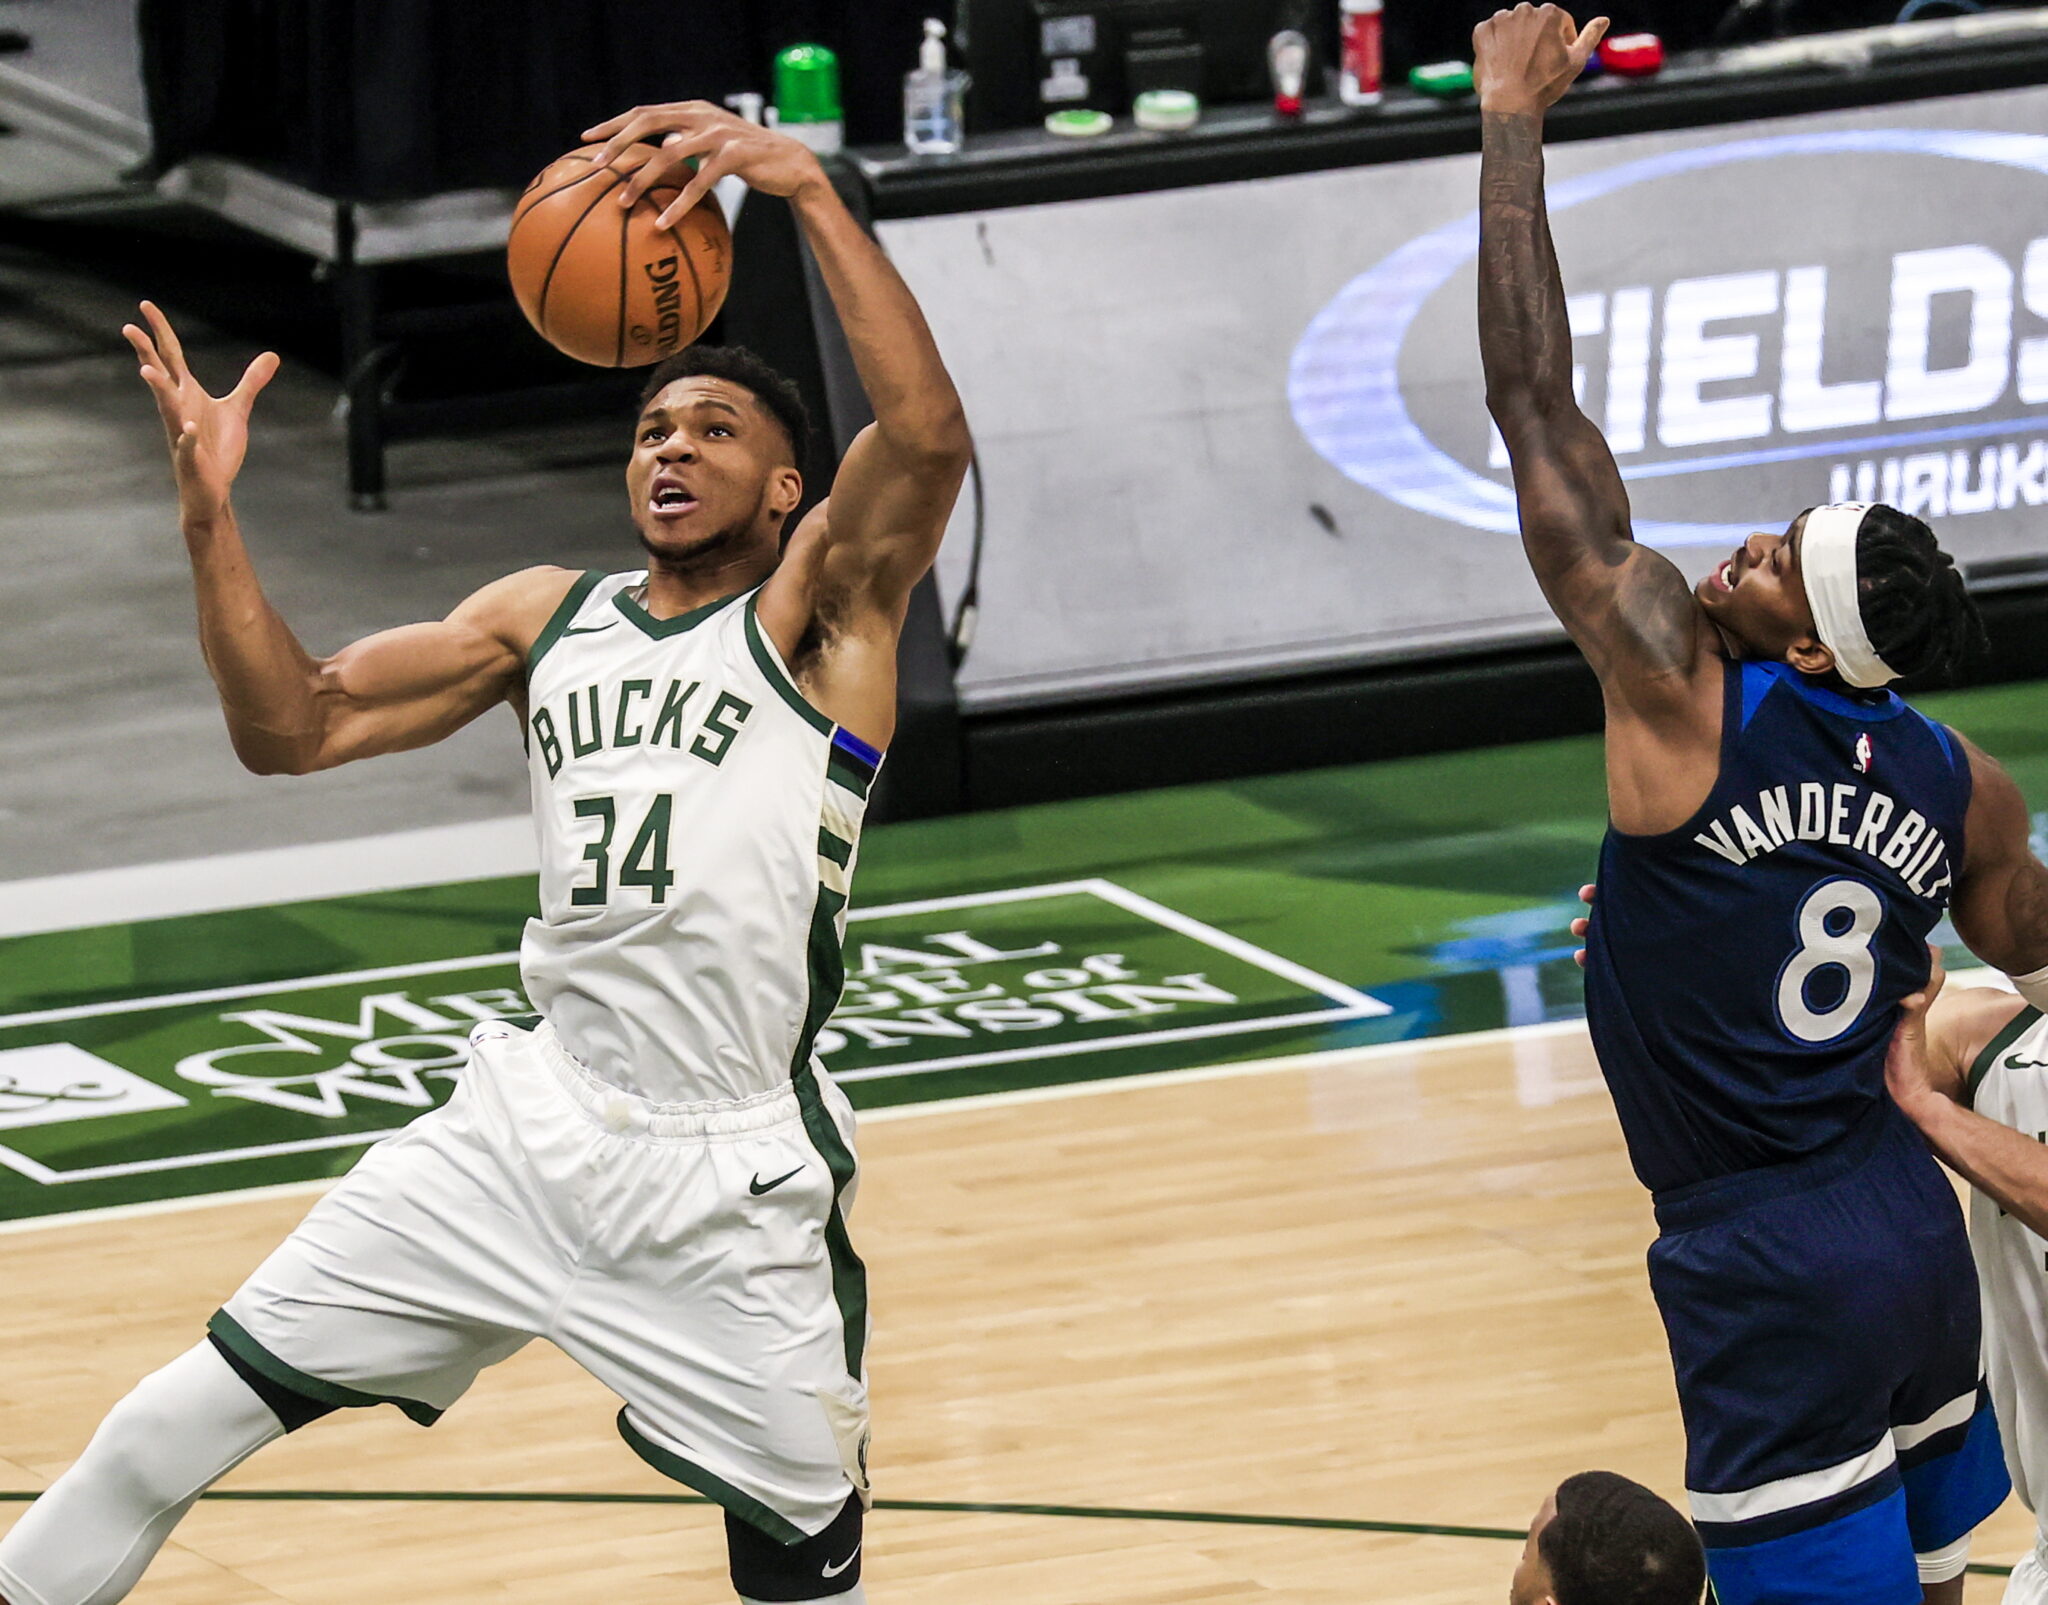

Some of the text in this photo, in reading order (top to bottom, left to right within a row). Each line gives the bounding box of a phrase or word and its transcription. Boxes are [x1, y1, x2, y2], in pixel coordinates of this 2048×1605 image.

[531, 678, 754, 783] BUCKS
[570, 792, 676, 908] 34
[1773, 875, 1887, 1046] 8
